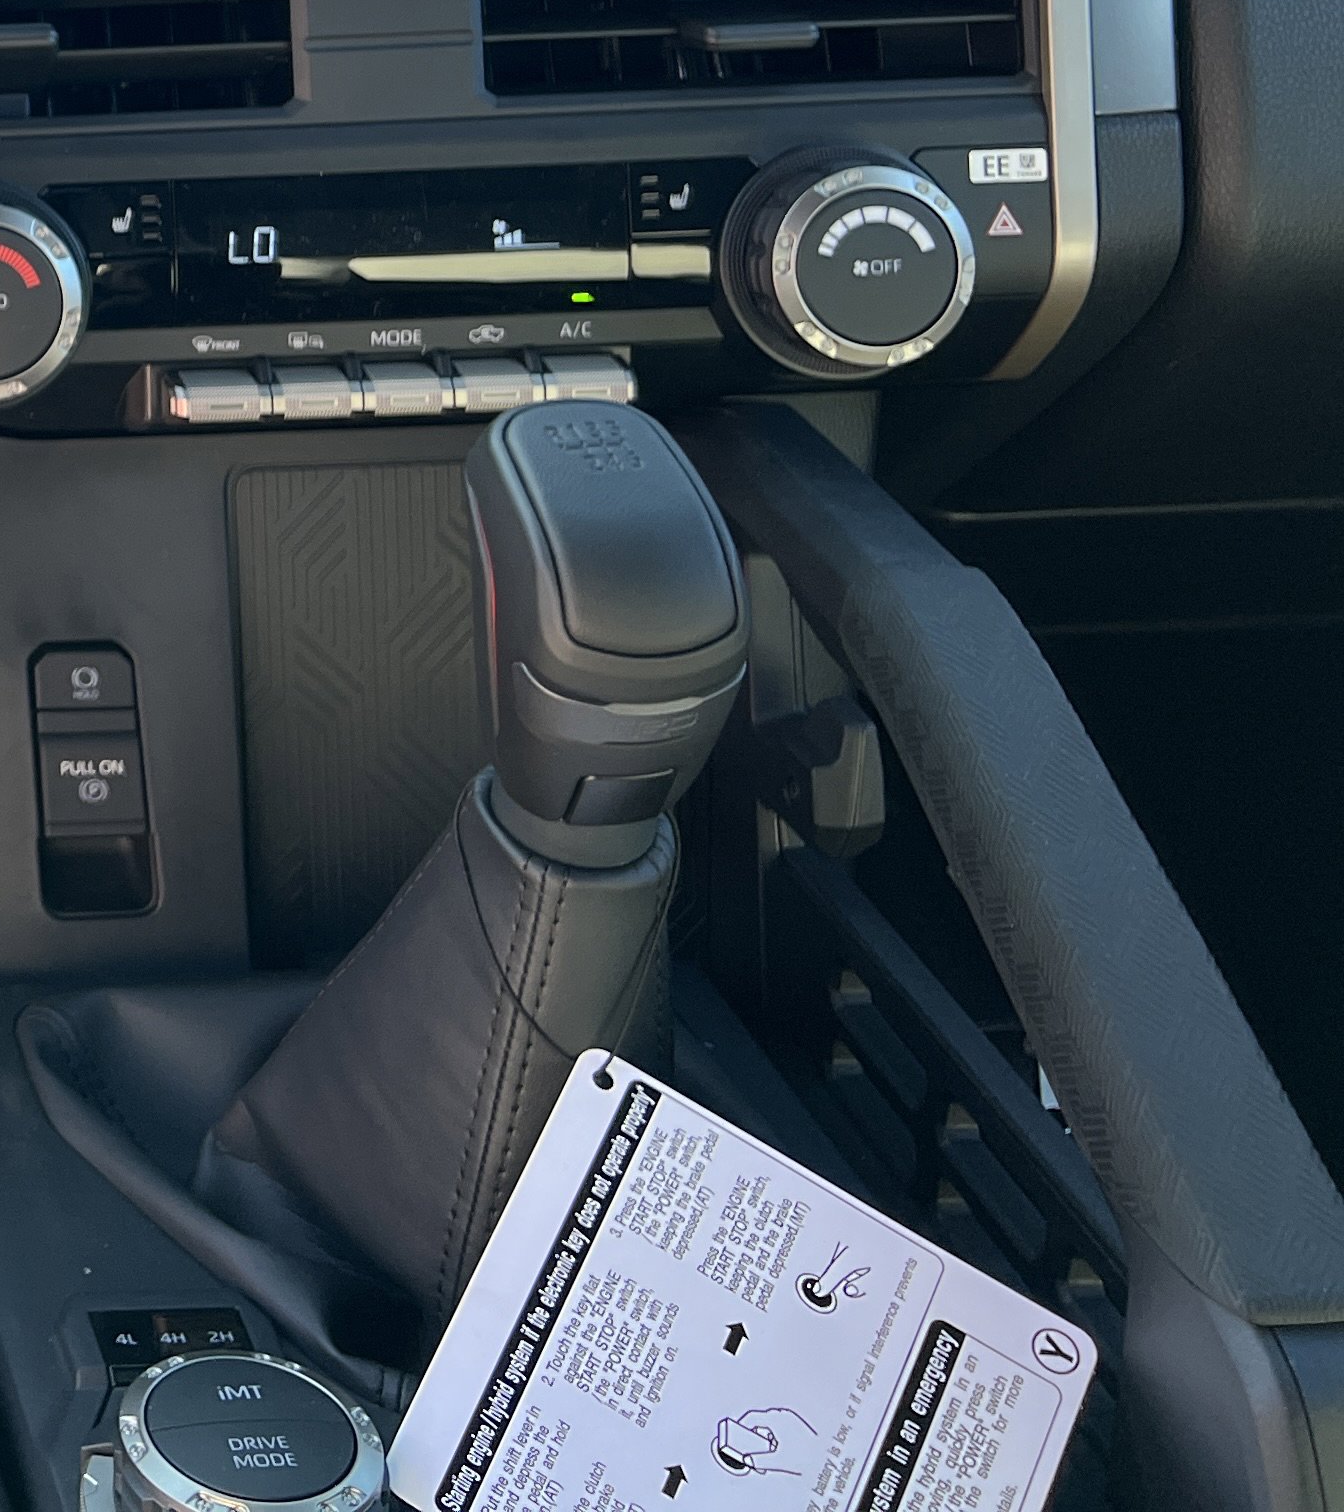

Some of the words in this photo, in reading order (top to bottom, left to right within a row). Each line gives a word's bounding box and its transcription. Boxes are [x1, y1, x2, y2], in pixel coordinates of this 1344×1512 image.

[983, 154, 1010, 177] EE
[870, 257, 903, 276] OFF
[371, 329, 423, 347] MODE
[559, 321, 593, 339] A/C
[212, 339, 240, 351] FRONT
[60, 760, 96, 776] PULL
[99, 759, 126, 776] ON
[602, 1135, 631, 1176] operate
[679, 1136, 702, 1167] switch,
[701, 1129, 719, 1162] pedal
[591, 1174, 611, 1199] not
[629, 1196, 653, 1235] START
[666, 1128, 686, 1159] switch
[630, 1177, 645, 1195] the
[683, 1161, 705, 1190] brake
[575, 1198, 601, 1228] does
[614, 1197, 636, 1226] Press
[676, 1192, 691, 1209] the
[562, 1228, 590, 1253] key
[610, 1228, 623, 1238] 3.
[656, 1211, 685, 1252] keeping
[538, 1251, 575, 1307] electronic
[582, 1274, 601, 1295] flat
[527, 1307, 550, 1329] the
[572, 1294, 593, 1317] key
[630, 1289, 655, 1325] switch,
[867, 1302, 899, 1359] interference
[895, 1258, 917, 1301] prevents
[115, 1333, 137, 1346] 4L
[160, 1331, 187, 1344] 4H
[208, 1330, 234, 1343] 2H
[520, 1324, 540, 1341] if
[563, 1318, 581, 1337] the
[577, 1352, 601, 1392] START
[616, 1278, 637, 1311] switch
[505, 1340, 534, 1383] system
[546, 1338, 572, 1372] Touch
[564, 1343, 588, 1383] against
[581, 1323, 597, 1341] the
[605, 1399, 619, 1410] in
[612, 1365, 633, 1396] direct
[628, 1323, 652, 1363] contact
[646, 1299, 663, 1321] with
[627, 1380, 644, 1404] until
[636, 1343, 660, 1378] buzzer
[657, 1303, 679, 1339] sounds
[1040, 1334, 1074, 1363] Y
[217, 1384, 261, 1401] iMT
[541, 1376, 555, 1387] 2.
[636, 1405, 651, 1428] and
[644, 1366, 669, 1403] ignition
[664, 1347, 678, 1362] on.
[887, 1445, 910, 1465] in
[900, 1420, 920, 1443] an
[911, 1330, 959, 1415] emergency
[916, 1445, 942, 1488] hybrid
[937, 1397, 962, 1447] system
[954, 1377, 970, 1391] in
[965, 1355, 978, 1373] an
[228, 1435, 289, 1452] DRIVE
[233, 1452, 298, 1469] MODE
[441, 1465, 481, 1512] Starting
